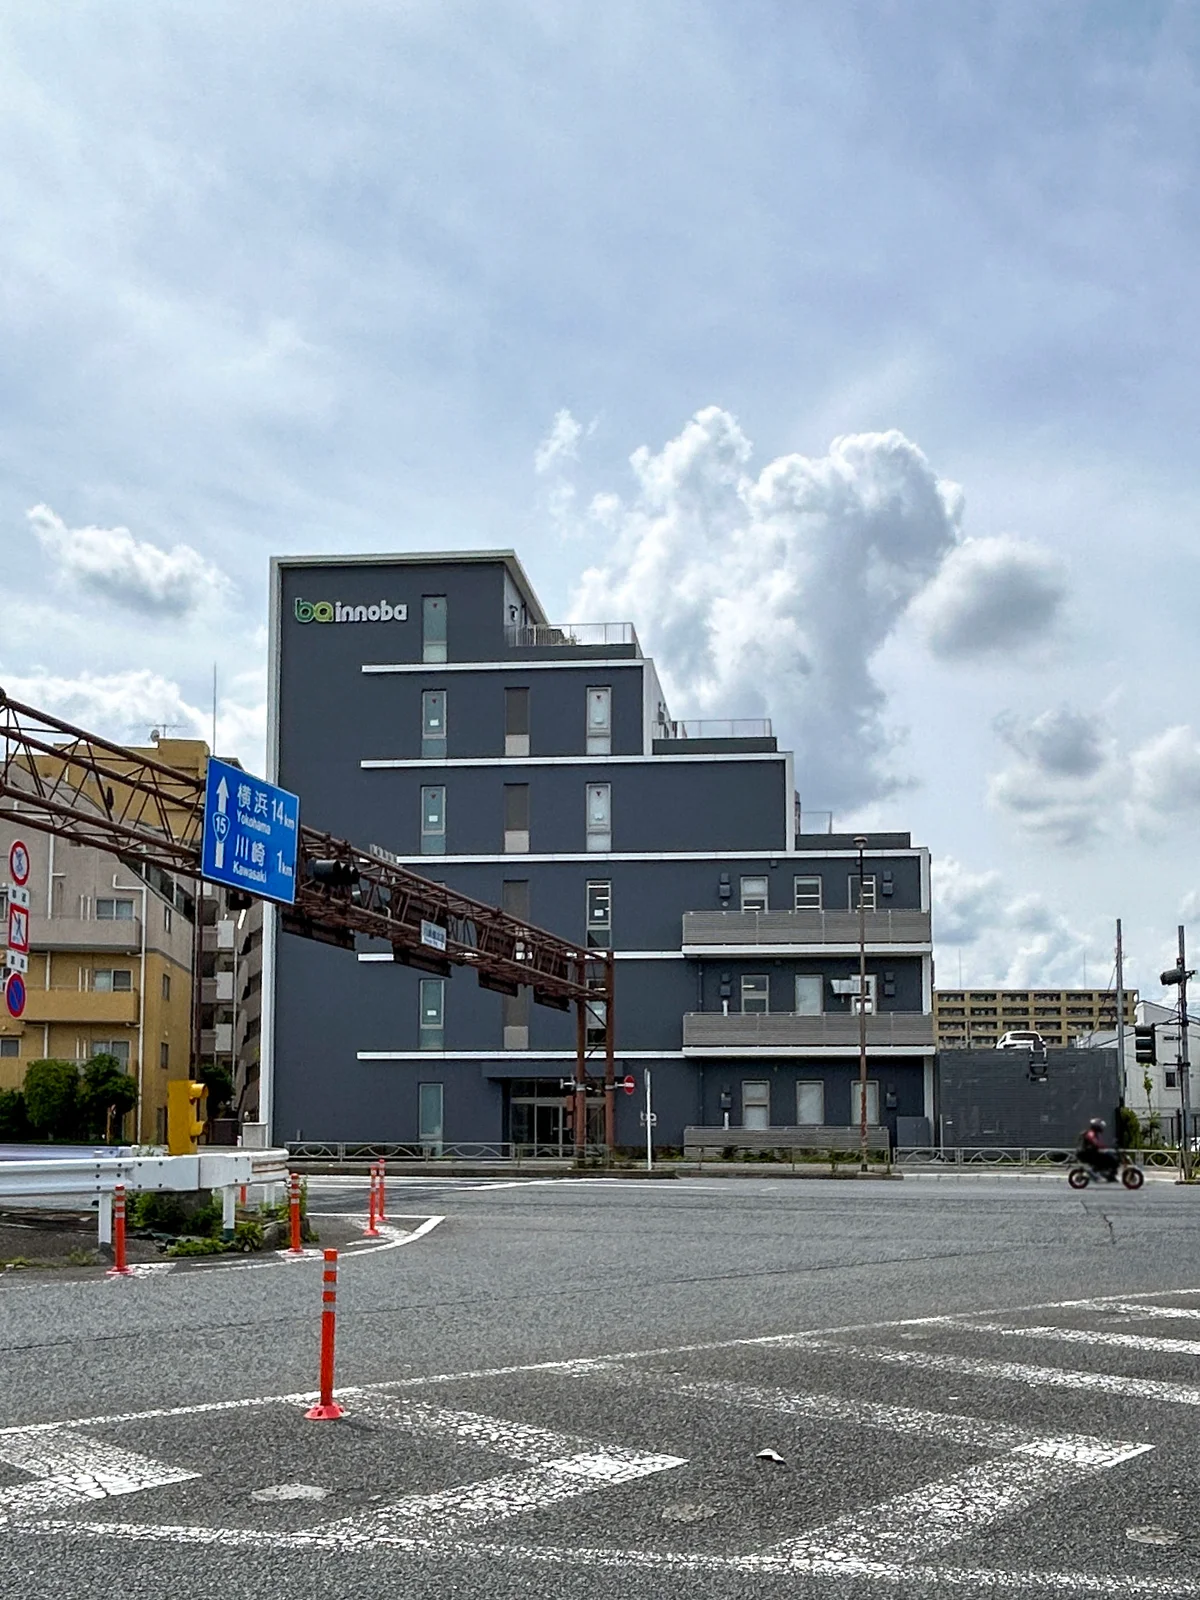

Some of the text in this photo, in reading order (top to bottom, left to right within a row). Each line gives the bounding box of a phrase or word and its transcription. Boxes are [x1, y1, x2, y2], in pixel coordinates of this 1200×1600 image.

[237, 782, 268, 818] 横浜
[215, 815, 227, 835] 15
[236, 809, 271, 836] Yokohama
[235, 833, 266, 867] 川崎
[232, 860, 267, 884] Kawasaki
